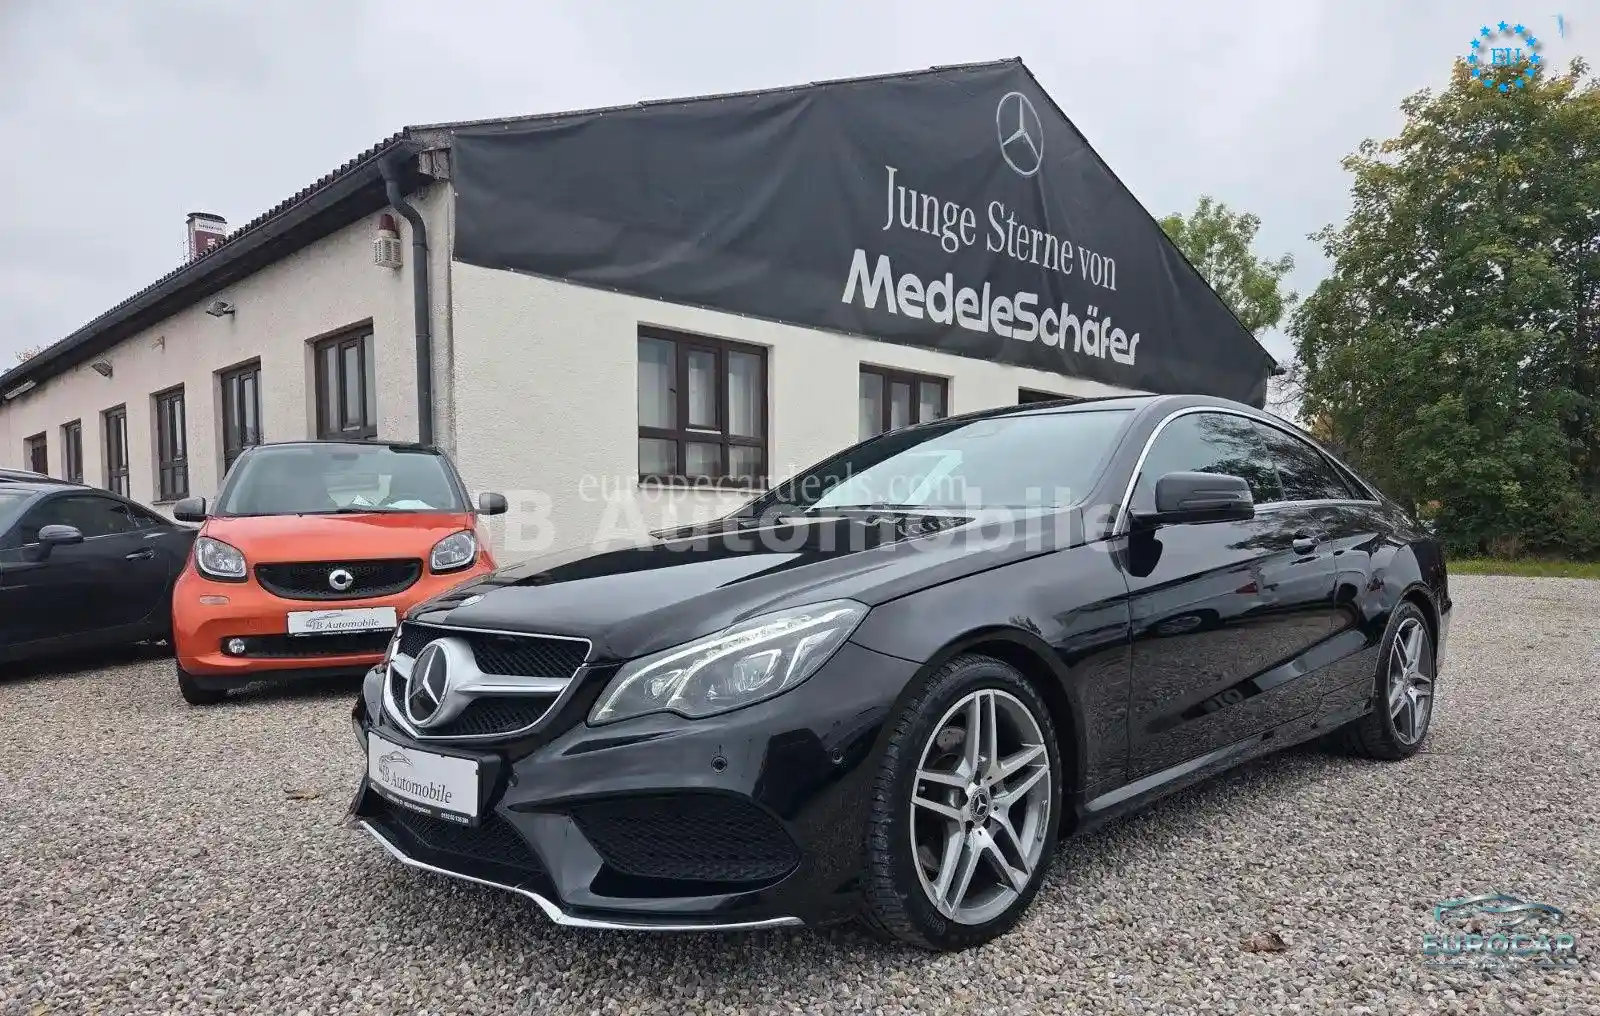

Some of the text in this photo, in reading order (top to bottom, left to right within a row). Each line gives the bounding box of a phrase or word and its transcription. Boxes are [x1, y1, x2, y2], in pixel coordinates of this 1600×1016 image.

[882, 165, 1118, 291] Junge Sterne von
[842, 248, 1140, 366] MedeleSchäfer
[325, 618, 380, 630] Automobile
[390, 771, 452, 804] Automobile
